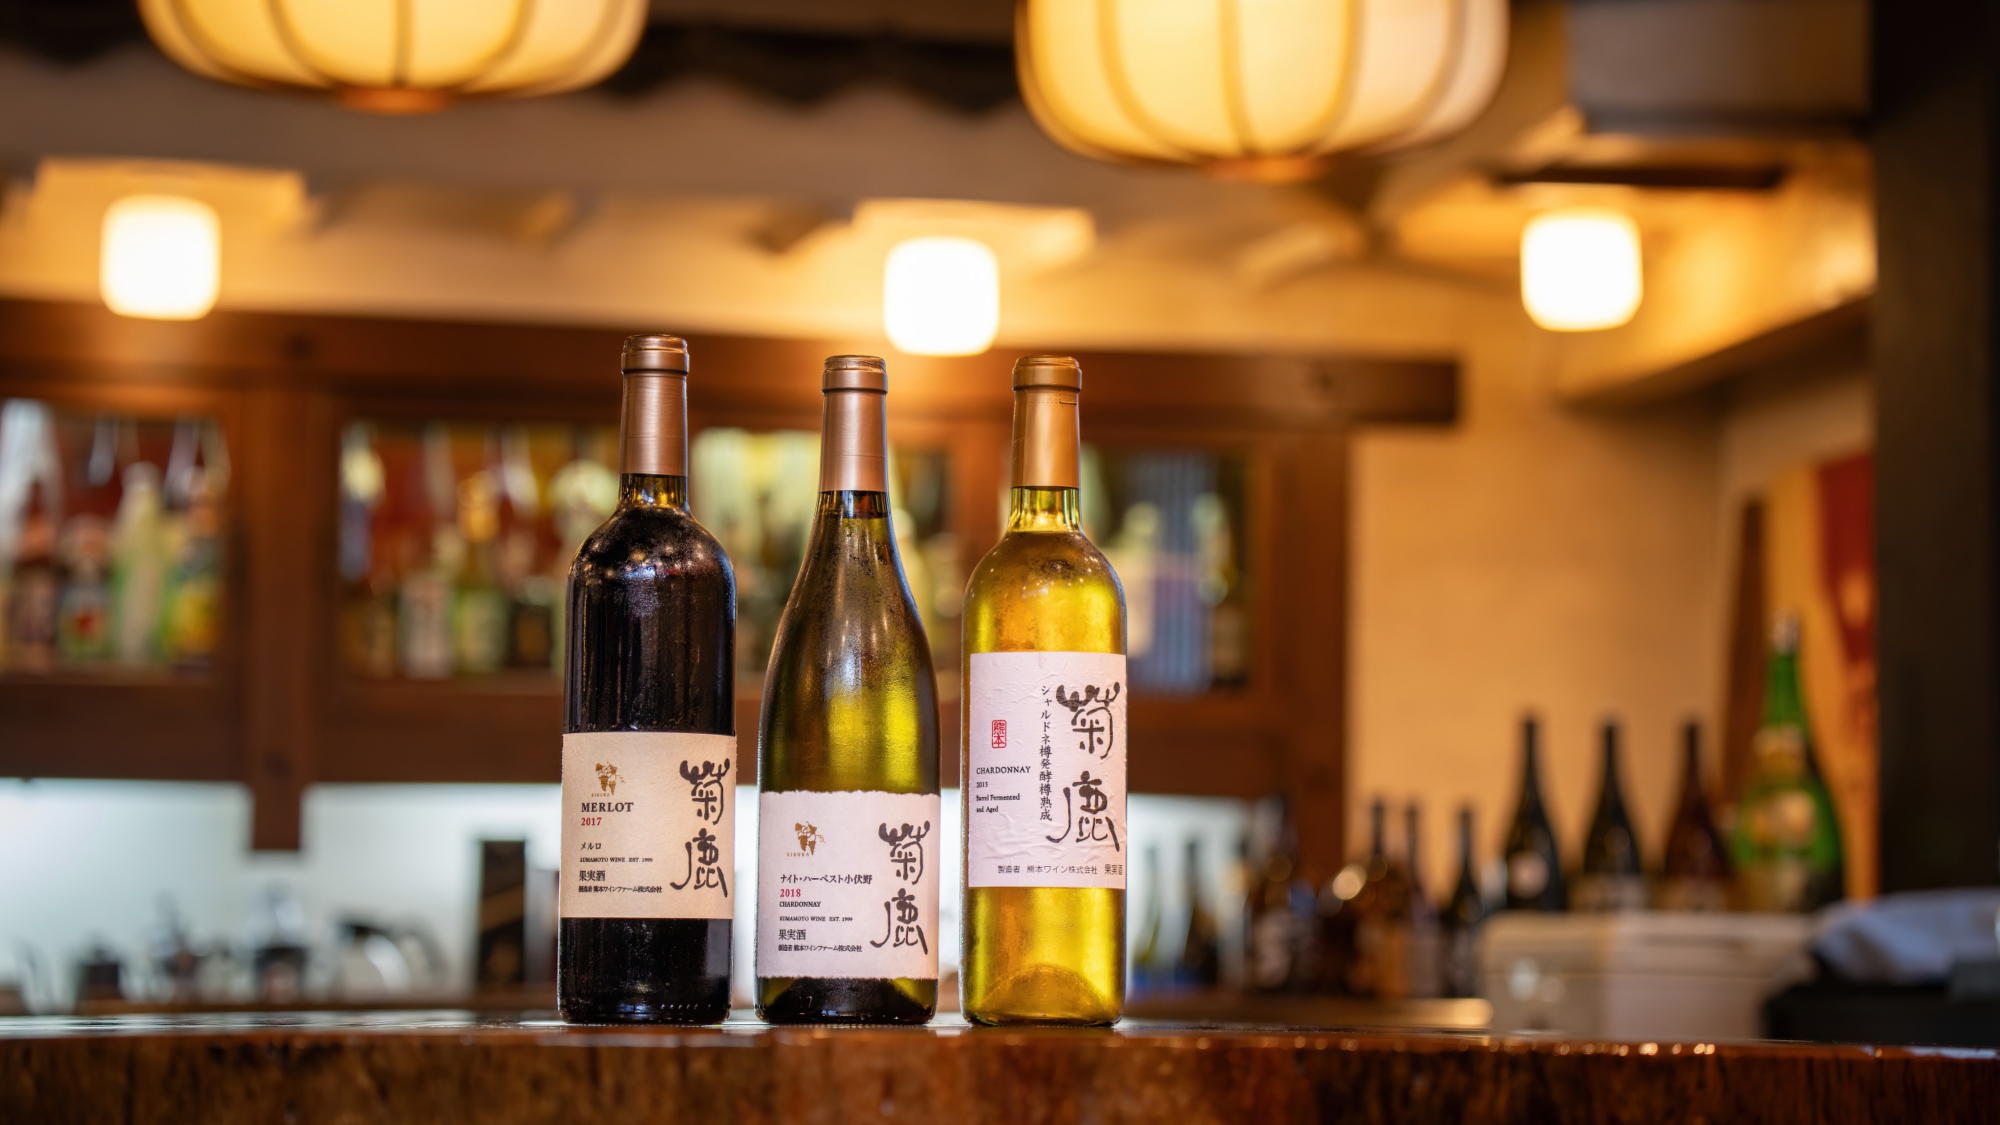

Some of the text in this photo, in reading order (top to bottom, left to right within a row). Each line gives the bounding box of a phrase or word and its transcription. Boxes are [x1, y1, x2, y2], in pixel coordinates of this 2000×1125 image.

[1039, 686, 1052, 821] シャルドネ樽発酵樽熟成
[976, 766, 1030, 774] CHARDONNAY
[1046, 682, 1120, 852] 菊鹿
[581, 802, 634, 812] MERLOT
[581, 817, 602, 826] 2017
[670, 758, 730, 898] 菊鹿
[580, 842, 601, 850] メルロ
[579, 870, 605, 881] 果実酒
[780, 888, 801, 897] 2018
[870, 820, 930, 955] 菊鹿
[778, 929, 806, 940] 果実酒
